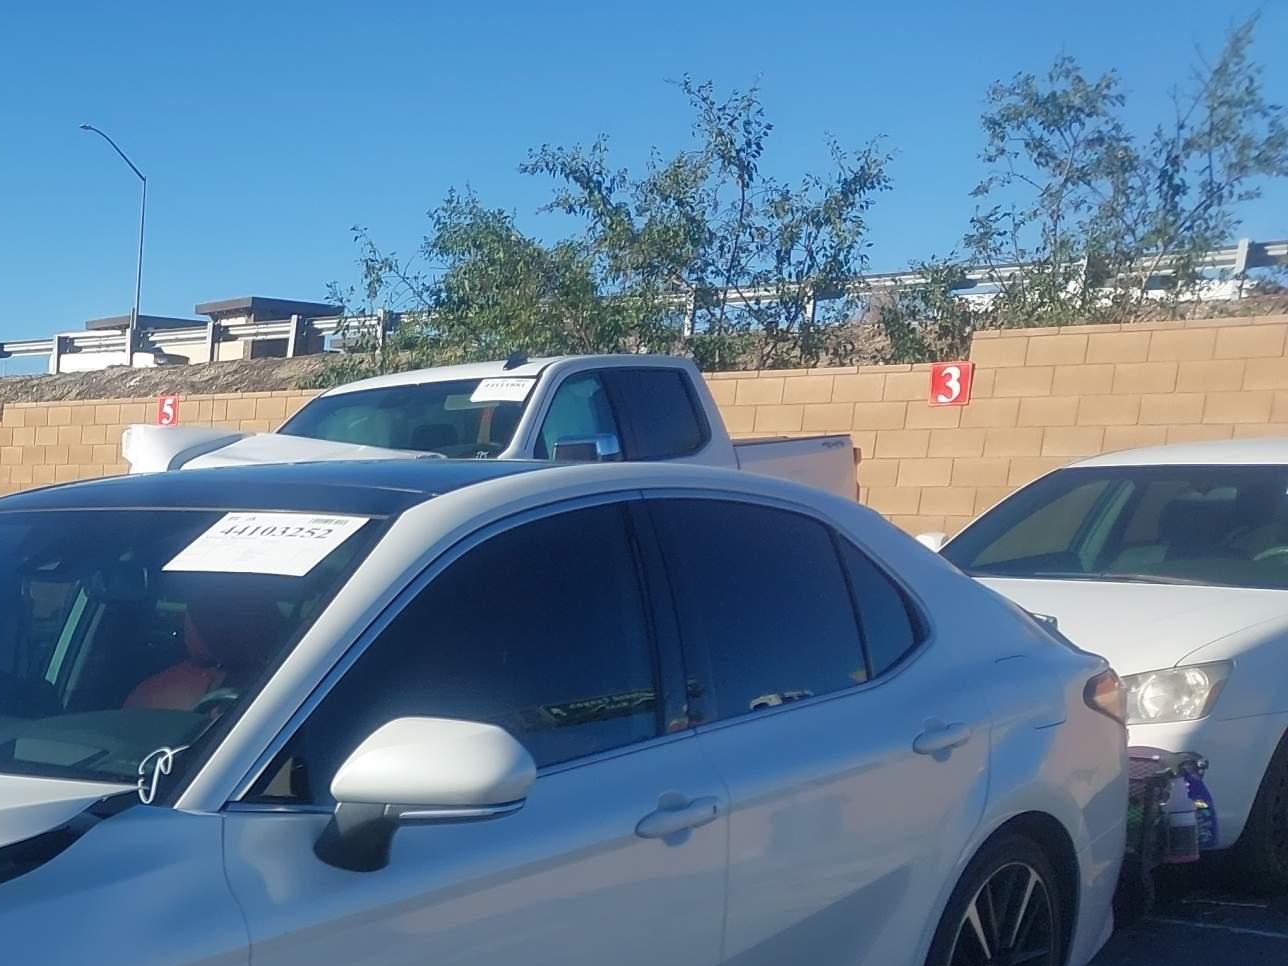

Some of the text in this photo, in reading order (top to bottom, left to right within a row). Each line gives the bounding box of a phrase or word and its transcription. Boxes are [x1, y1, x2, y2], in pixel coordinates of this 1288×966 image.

[937, 366, 961, 403] 3
[162, 398, 174, 425] 5
[219, 525, 334, 539] 44103252
